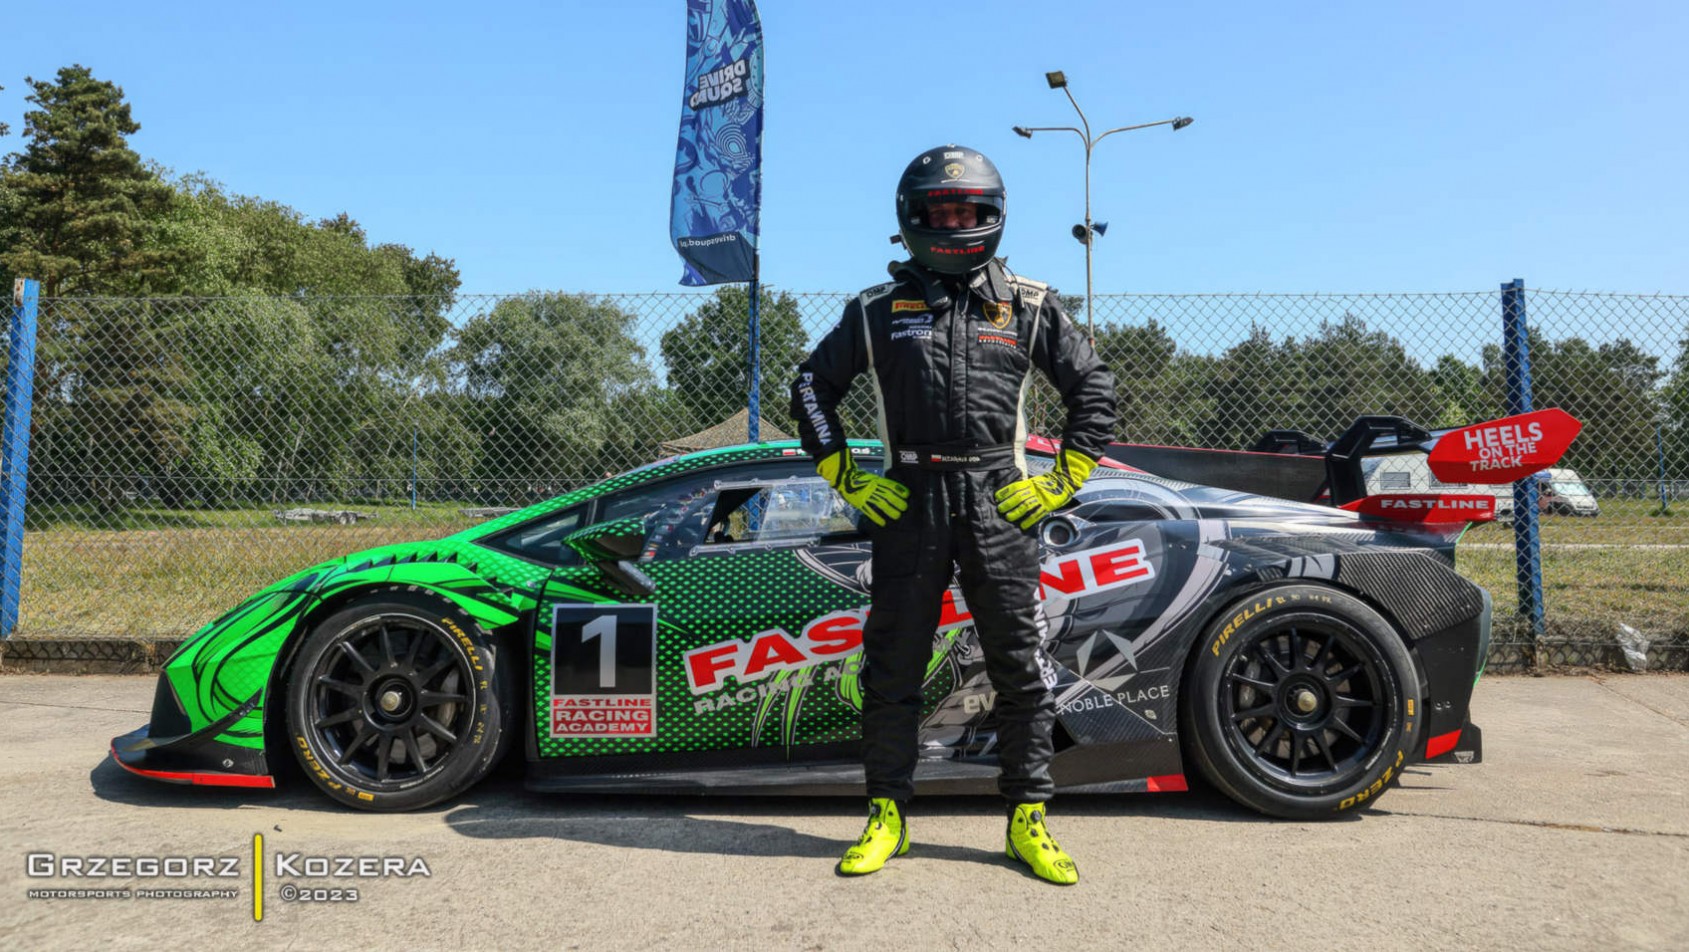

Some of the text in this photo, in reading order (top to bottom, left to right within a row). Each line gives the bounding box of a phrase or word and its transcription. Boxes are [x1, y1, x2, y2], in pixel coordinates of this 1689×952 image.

[1464, 422, 1543, 450] HEELS
[1479, 441, 1537, 459] ON THE
[1469, 456, 1523, 472] TRACK
[1381, 499, 1489, 509] FASTLINE
[687, 544, 1150, 690] FASLNE
[1212, 598, 1273, 657] PIRELLI
[441, 617, 484, 671] PIRELLI
[581, 615, 617, 687] 1
[553, 699, 652, 707] FASTLINE
[693, 673, 813, 714] RACING
[1060, 684, 1170, 715] NOBLE PLACE
[555, 710, 649, 721] RACING
[556, 722, 648, 732] ACADEMY
[296, 736, 331, 780] ZERO
[1339, 766, 1394, 810] ZERO
